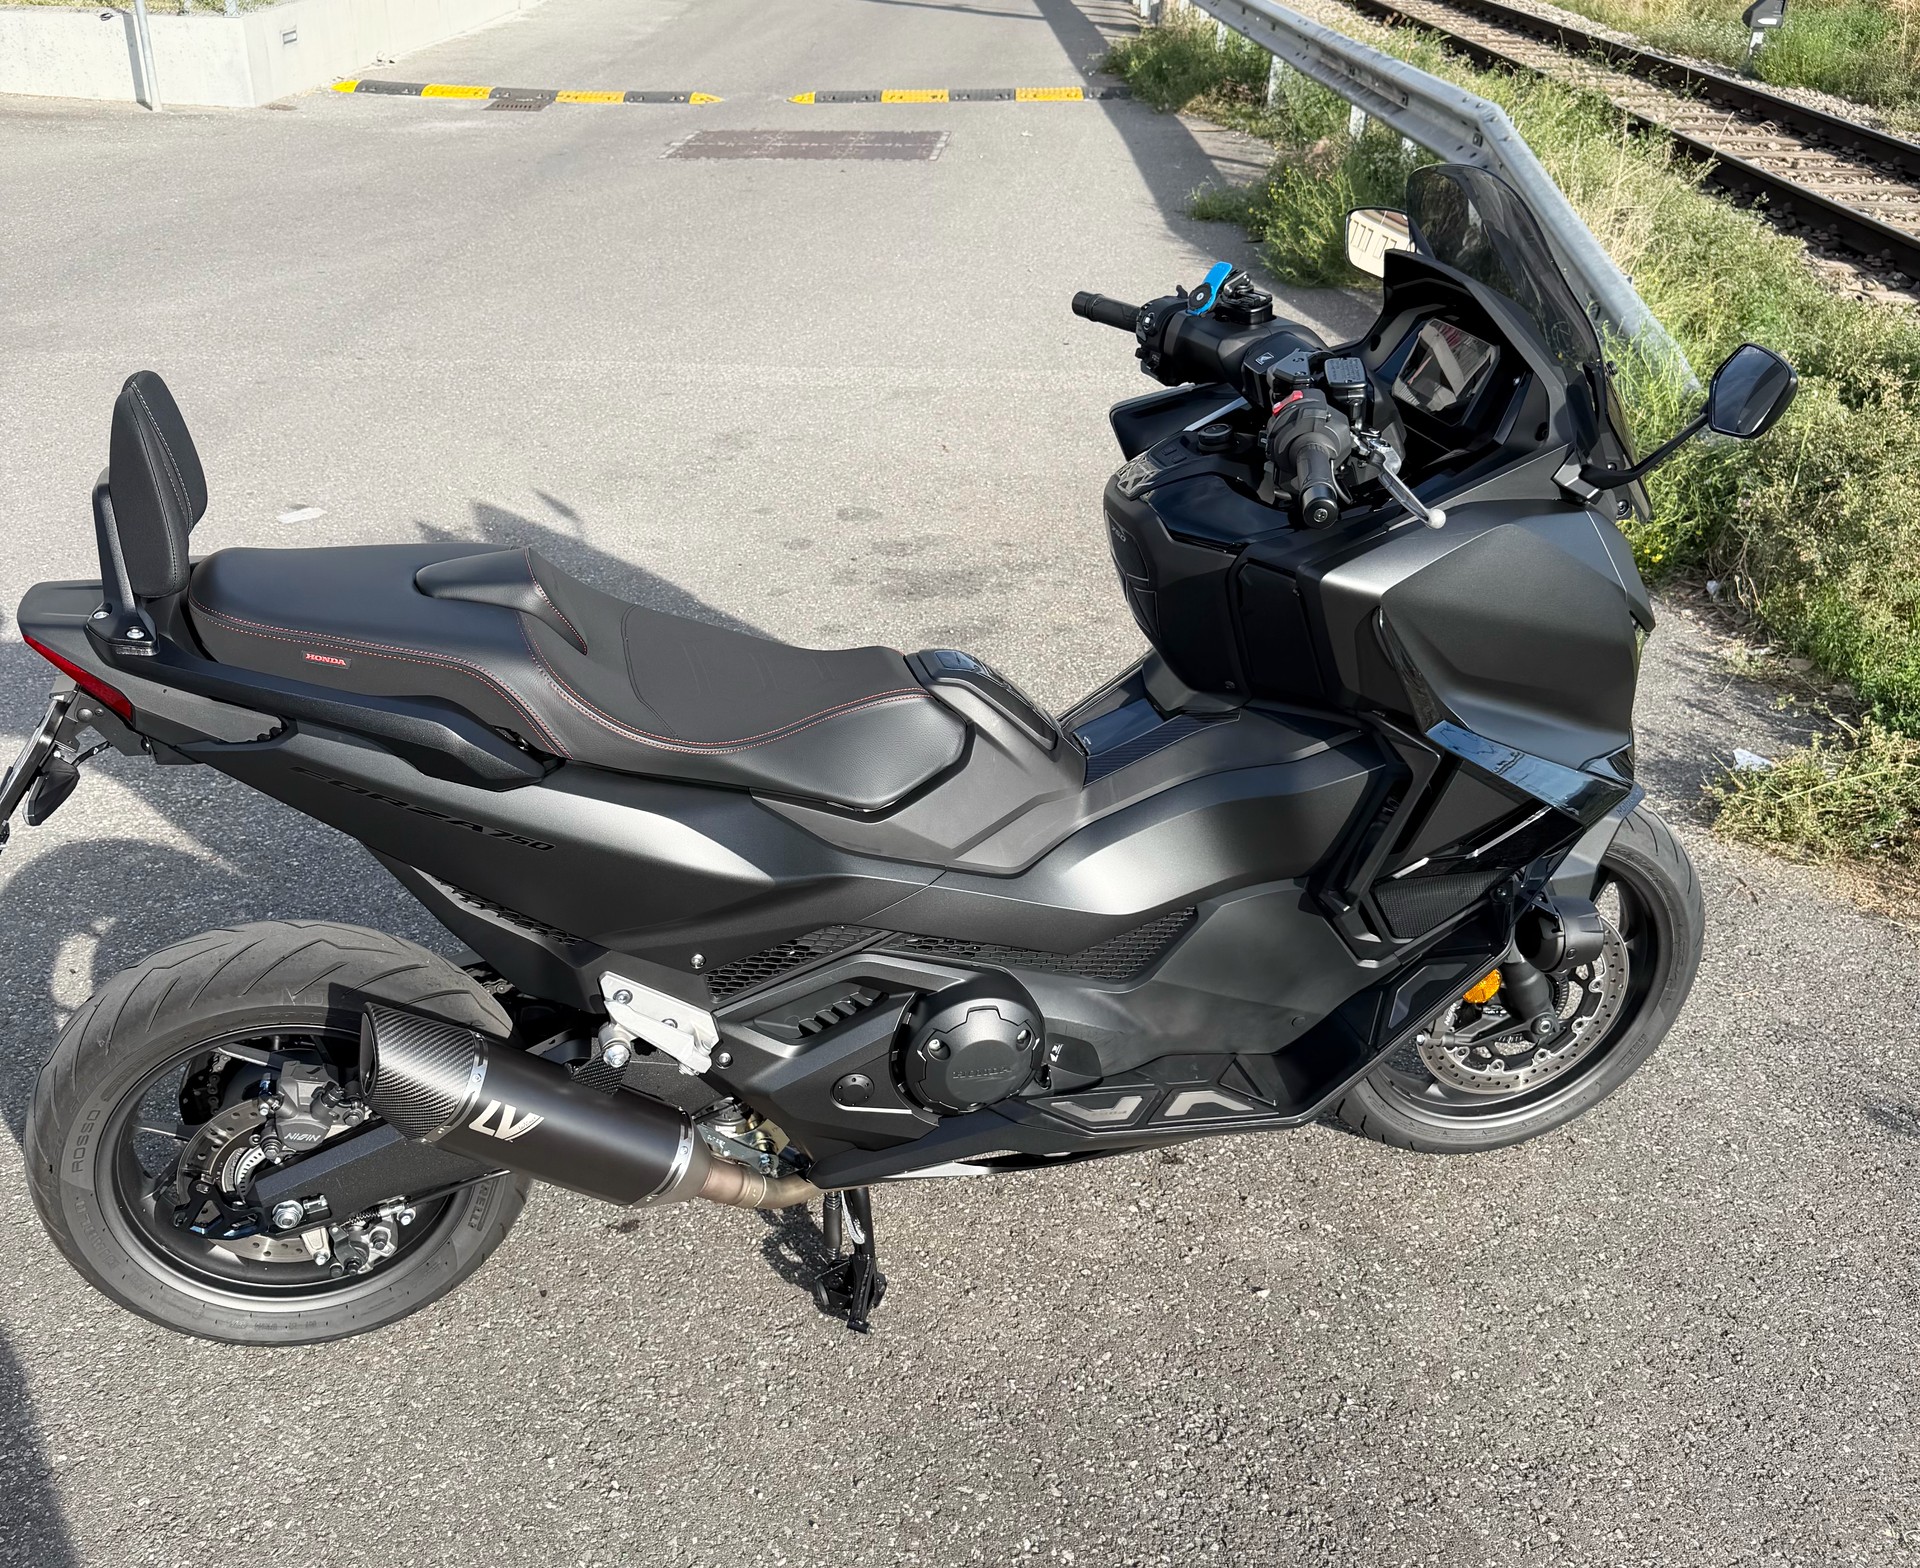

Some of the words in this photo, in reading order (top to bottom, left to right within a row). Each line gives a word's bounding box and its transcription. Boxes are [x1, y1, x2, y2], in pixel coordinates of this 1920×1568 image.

[305, 653, 347, 666] HONDA
[290, 765, 485, 834] FORZA
[488, 828, 556, 852] 750
[71, 1109, 102, 1174] ROSSO
[468, 1099, 545, 1142] LV
